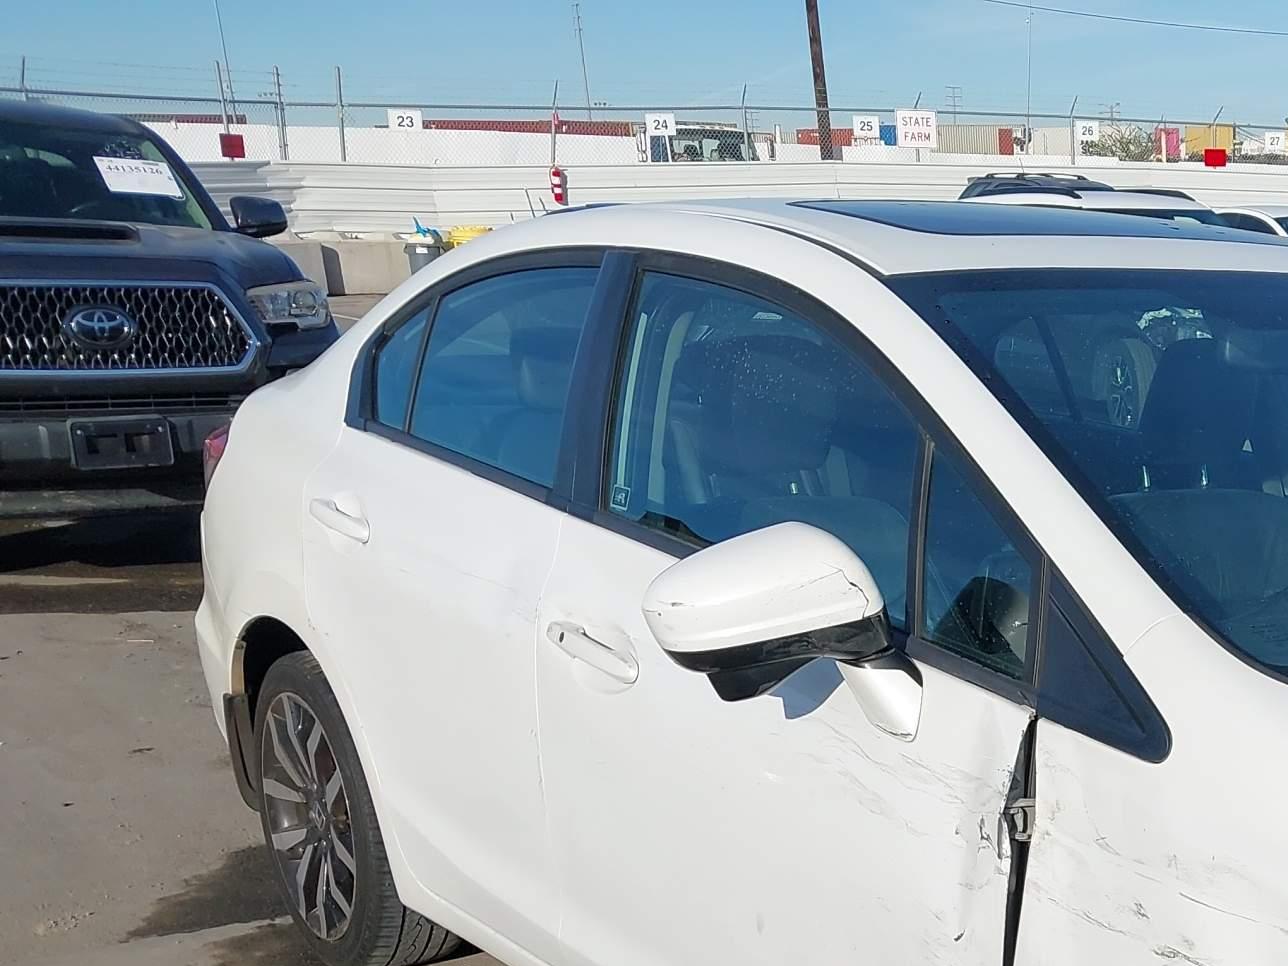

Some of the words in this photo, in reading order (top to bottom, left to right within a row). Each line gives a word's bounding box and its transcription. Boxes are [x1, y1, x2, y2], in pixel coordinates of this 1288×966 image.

[396, 115, 415, 128] 23
[652, 118, 669, 131] 24
[859, 120, 873, 132] 25
[901, 116, 931, 127] STATE
[1081, 125, 1094, 136] 26
[904, 131, 931, 142] FARM
[1269, 136, 1281, 147] 27
